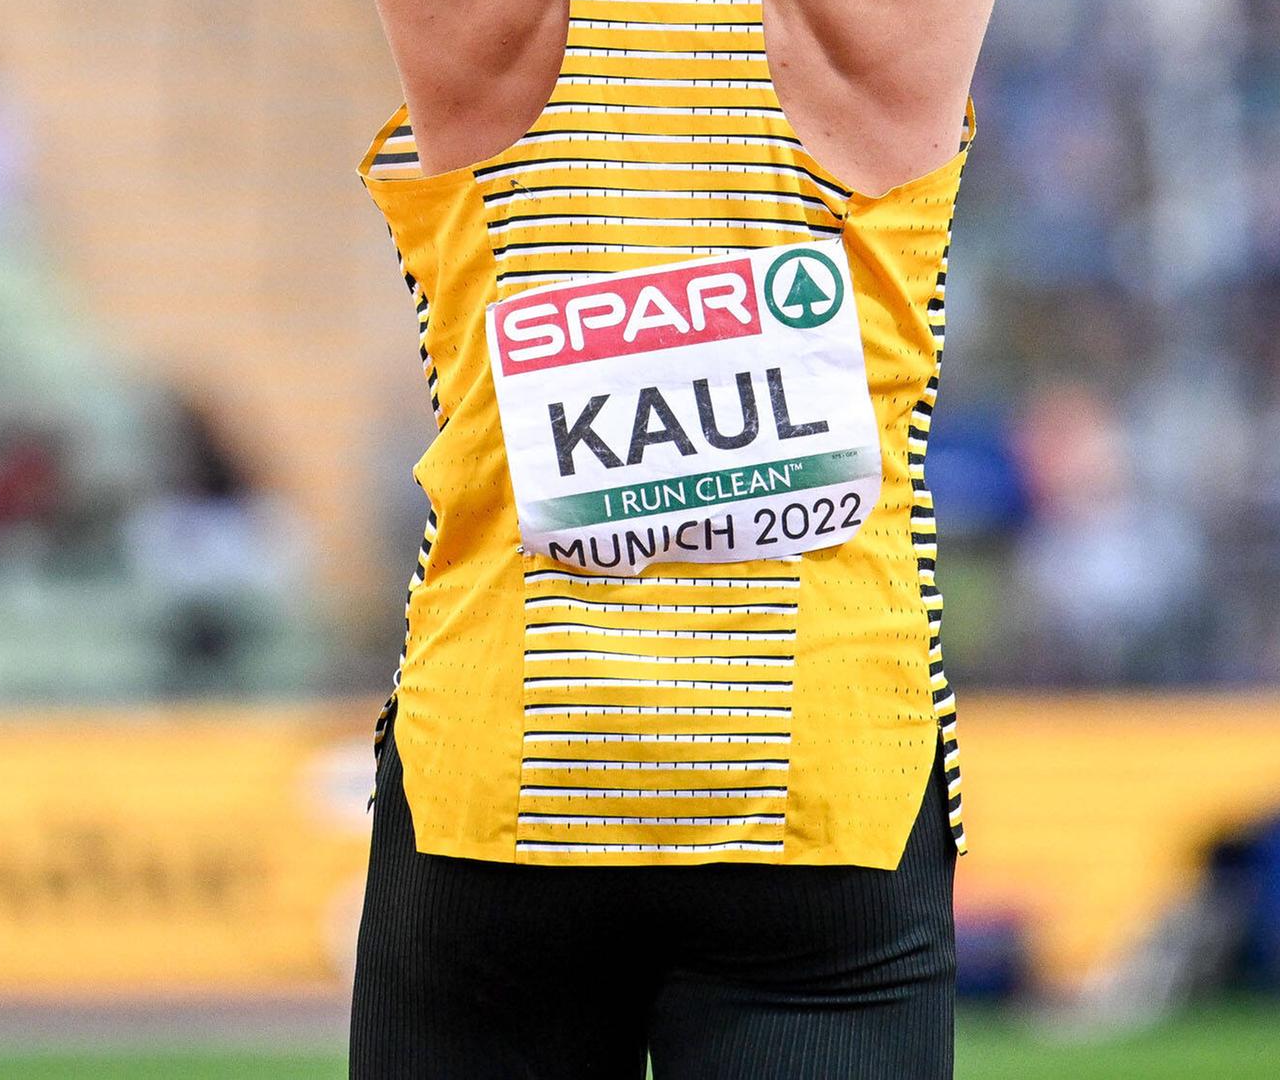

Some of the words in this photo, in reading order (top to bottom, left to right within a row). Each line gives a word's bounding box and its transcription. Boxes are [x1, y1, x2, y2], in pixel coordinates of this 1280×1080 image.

[503, 272, 752, 362] SPAR
[548, 367, 829, 477] KAUL
[549, 514, 735, 568] MUNICH
[754, 492, 862, 546] 2022
[604, 494, 612, 517] I
[621, 482, 686, 514] RUN
